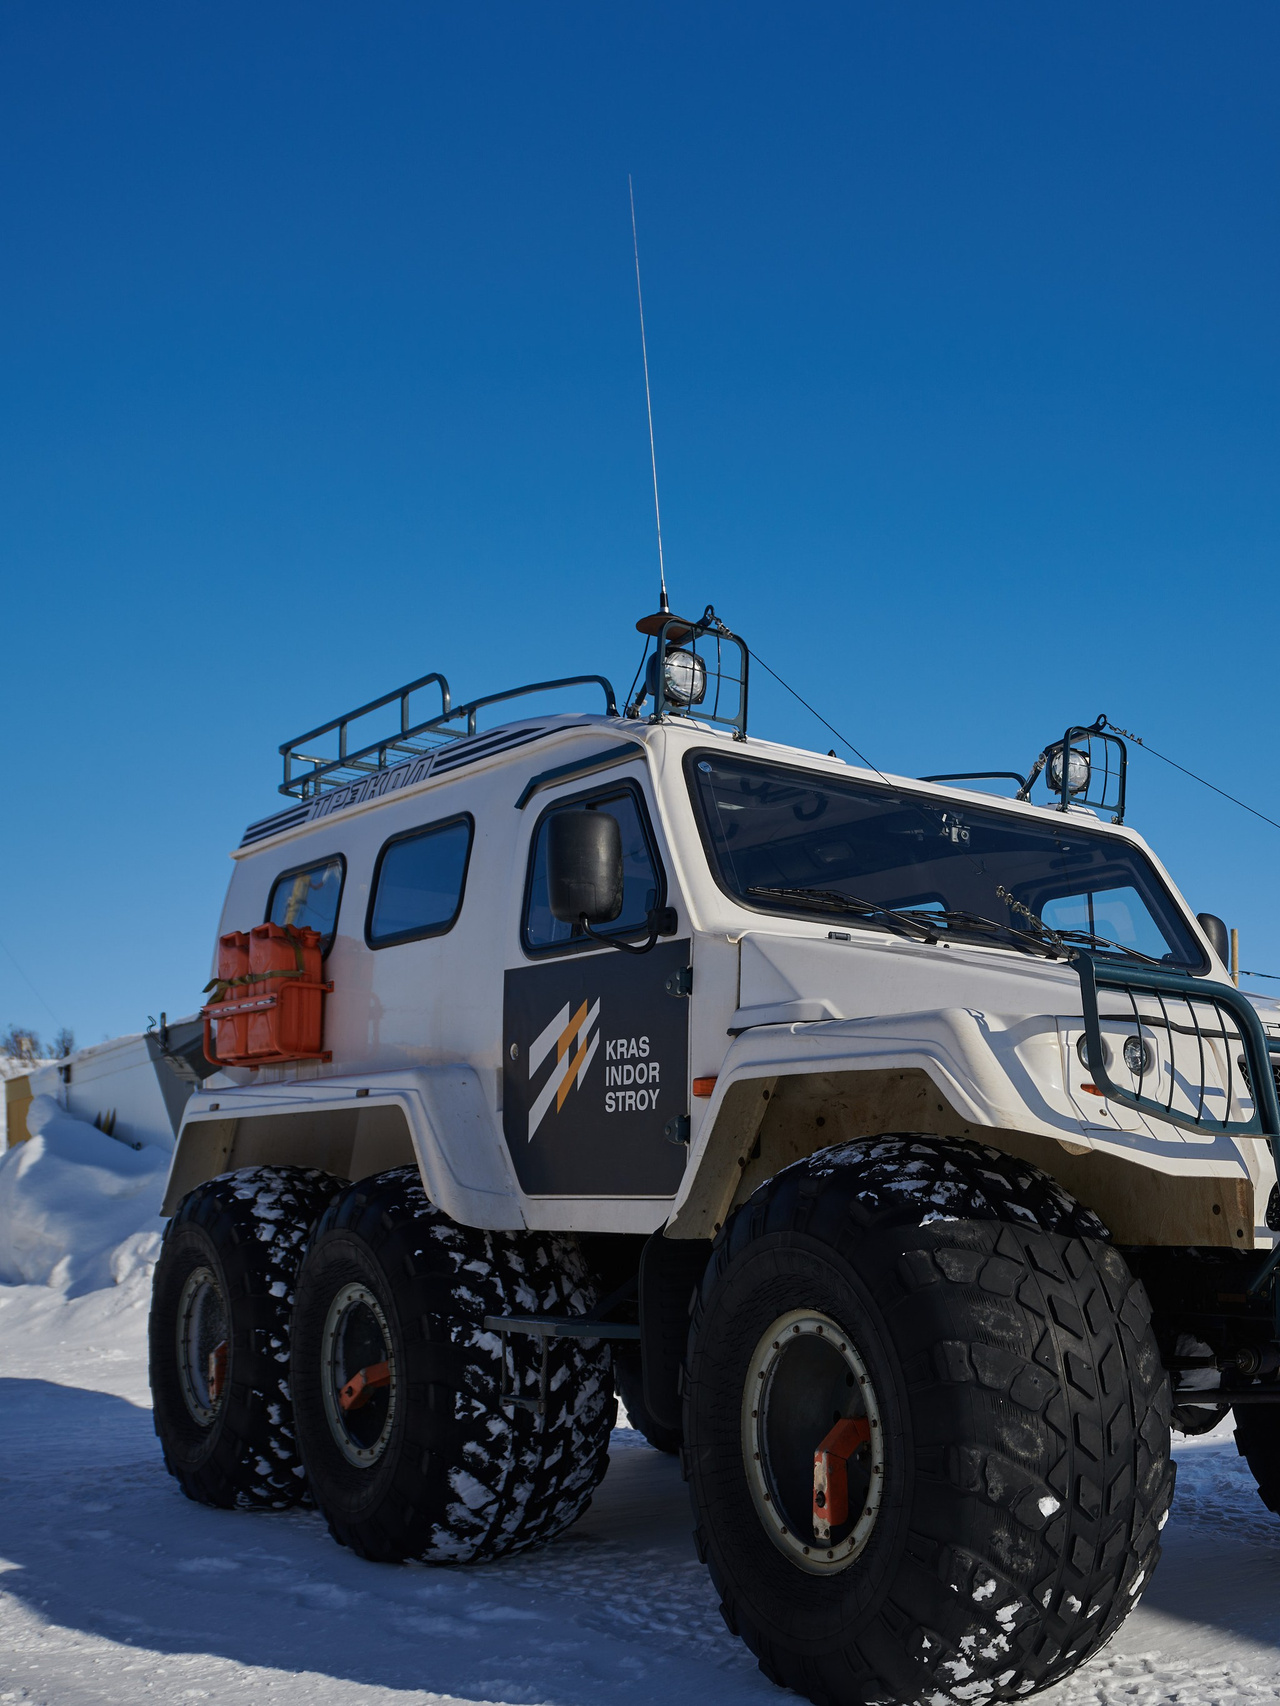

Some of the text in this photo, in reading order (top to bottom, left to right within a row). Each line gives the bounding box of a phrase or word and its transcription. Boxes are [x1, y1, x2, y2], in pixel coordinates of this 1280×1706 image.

[605, 1036, 650, 1061] KRAS
[605, 1062, 661, 1087] INDOR
[605, 1088, 661, 1113] STROY
